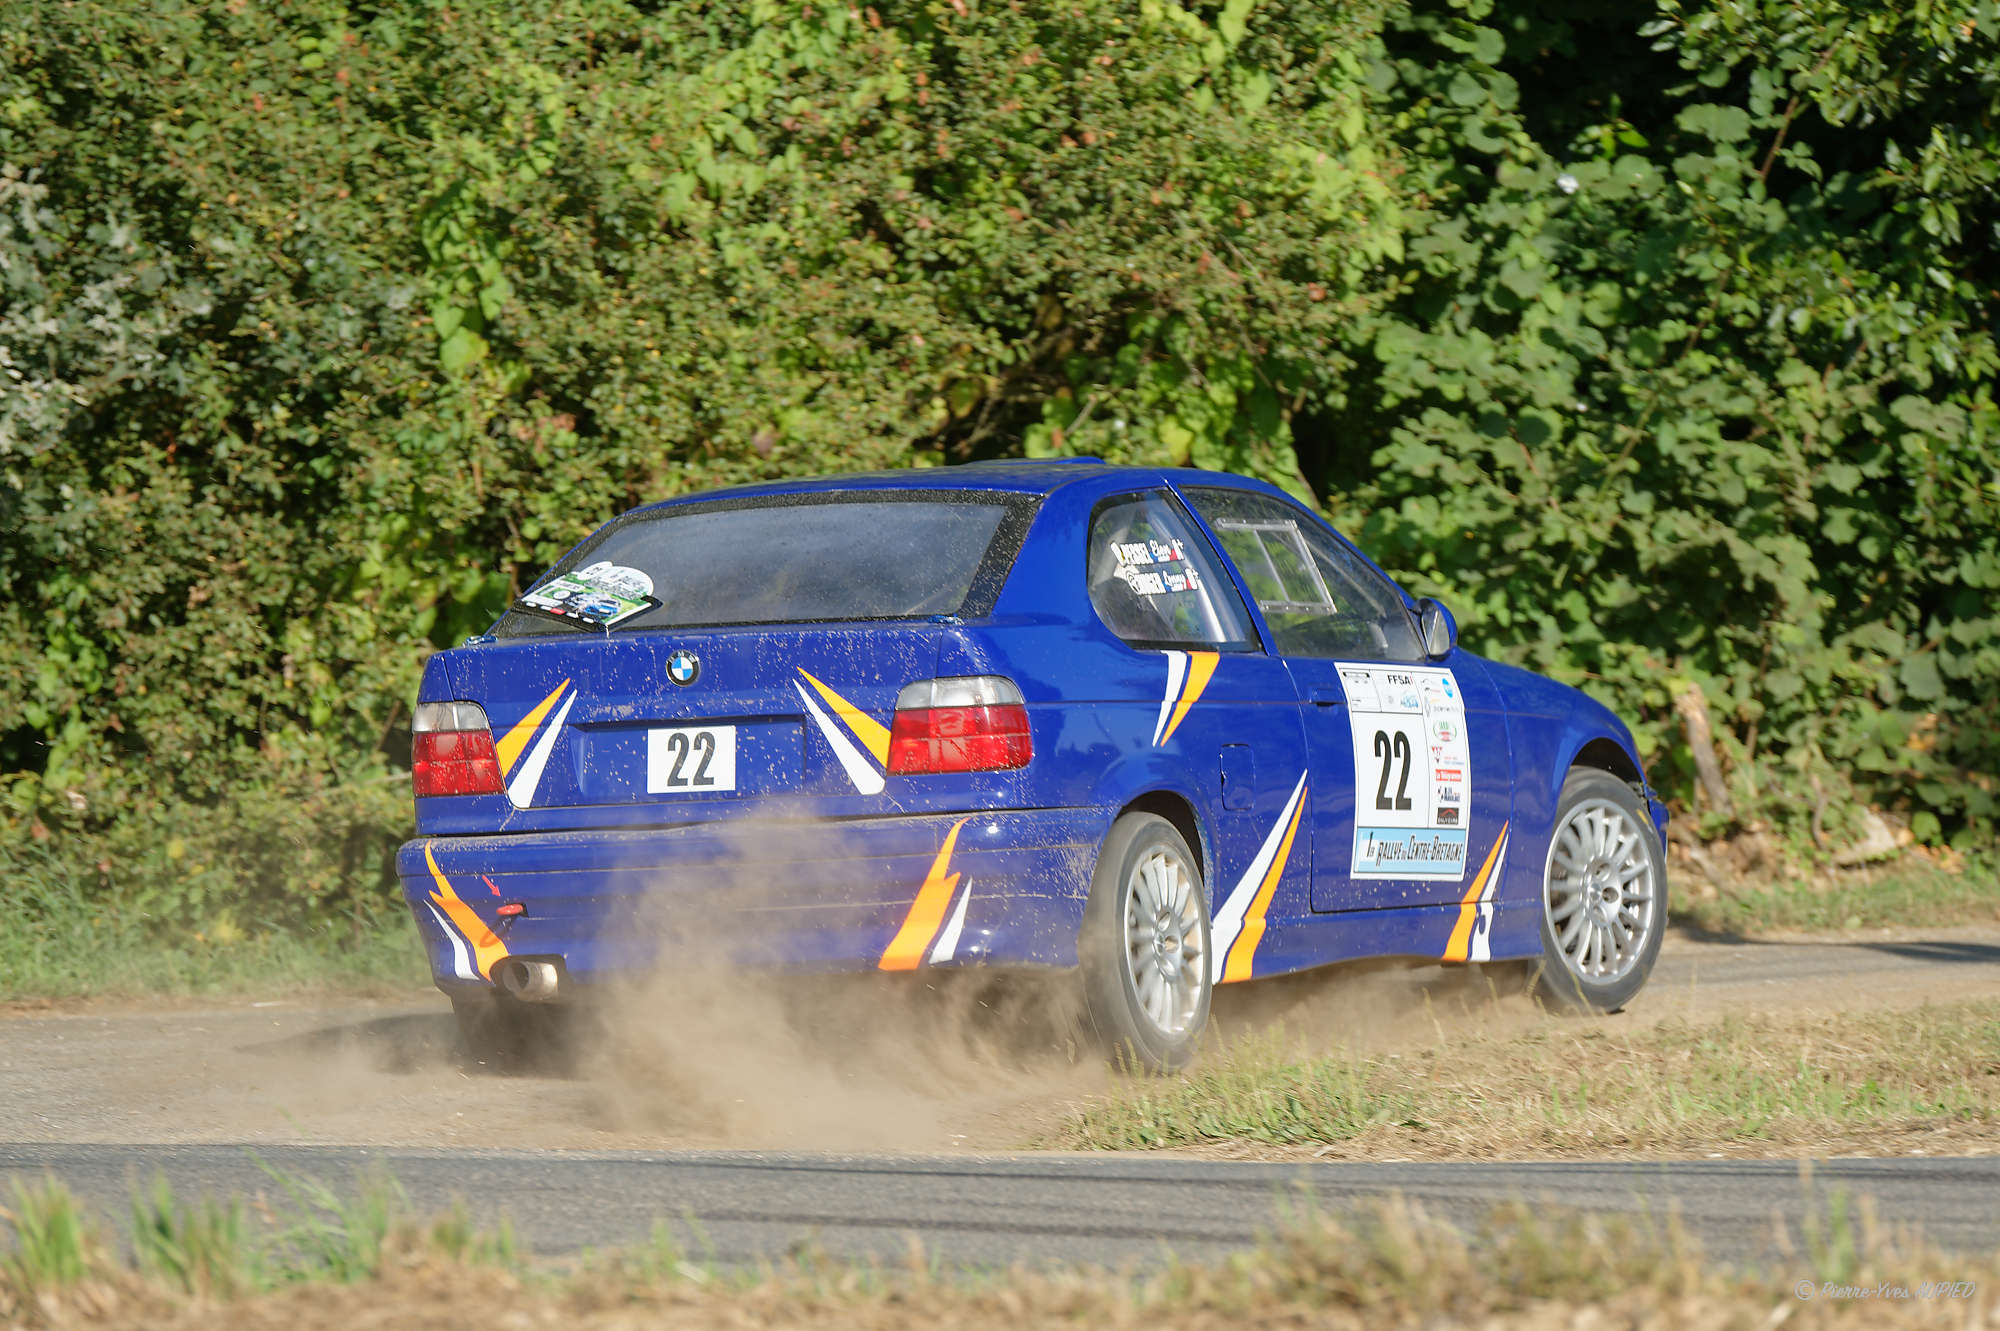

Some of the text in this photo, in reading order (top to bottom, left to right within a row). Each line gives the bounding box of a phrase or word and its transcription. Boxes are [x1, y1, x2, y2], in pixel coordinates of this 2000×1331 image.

[1387, 674, 1412, 685] FFSA
[667, 731, 716, 787] 22
[1374, 730, 1412, 811] 22
